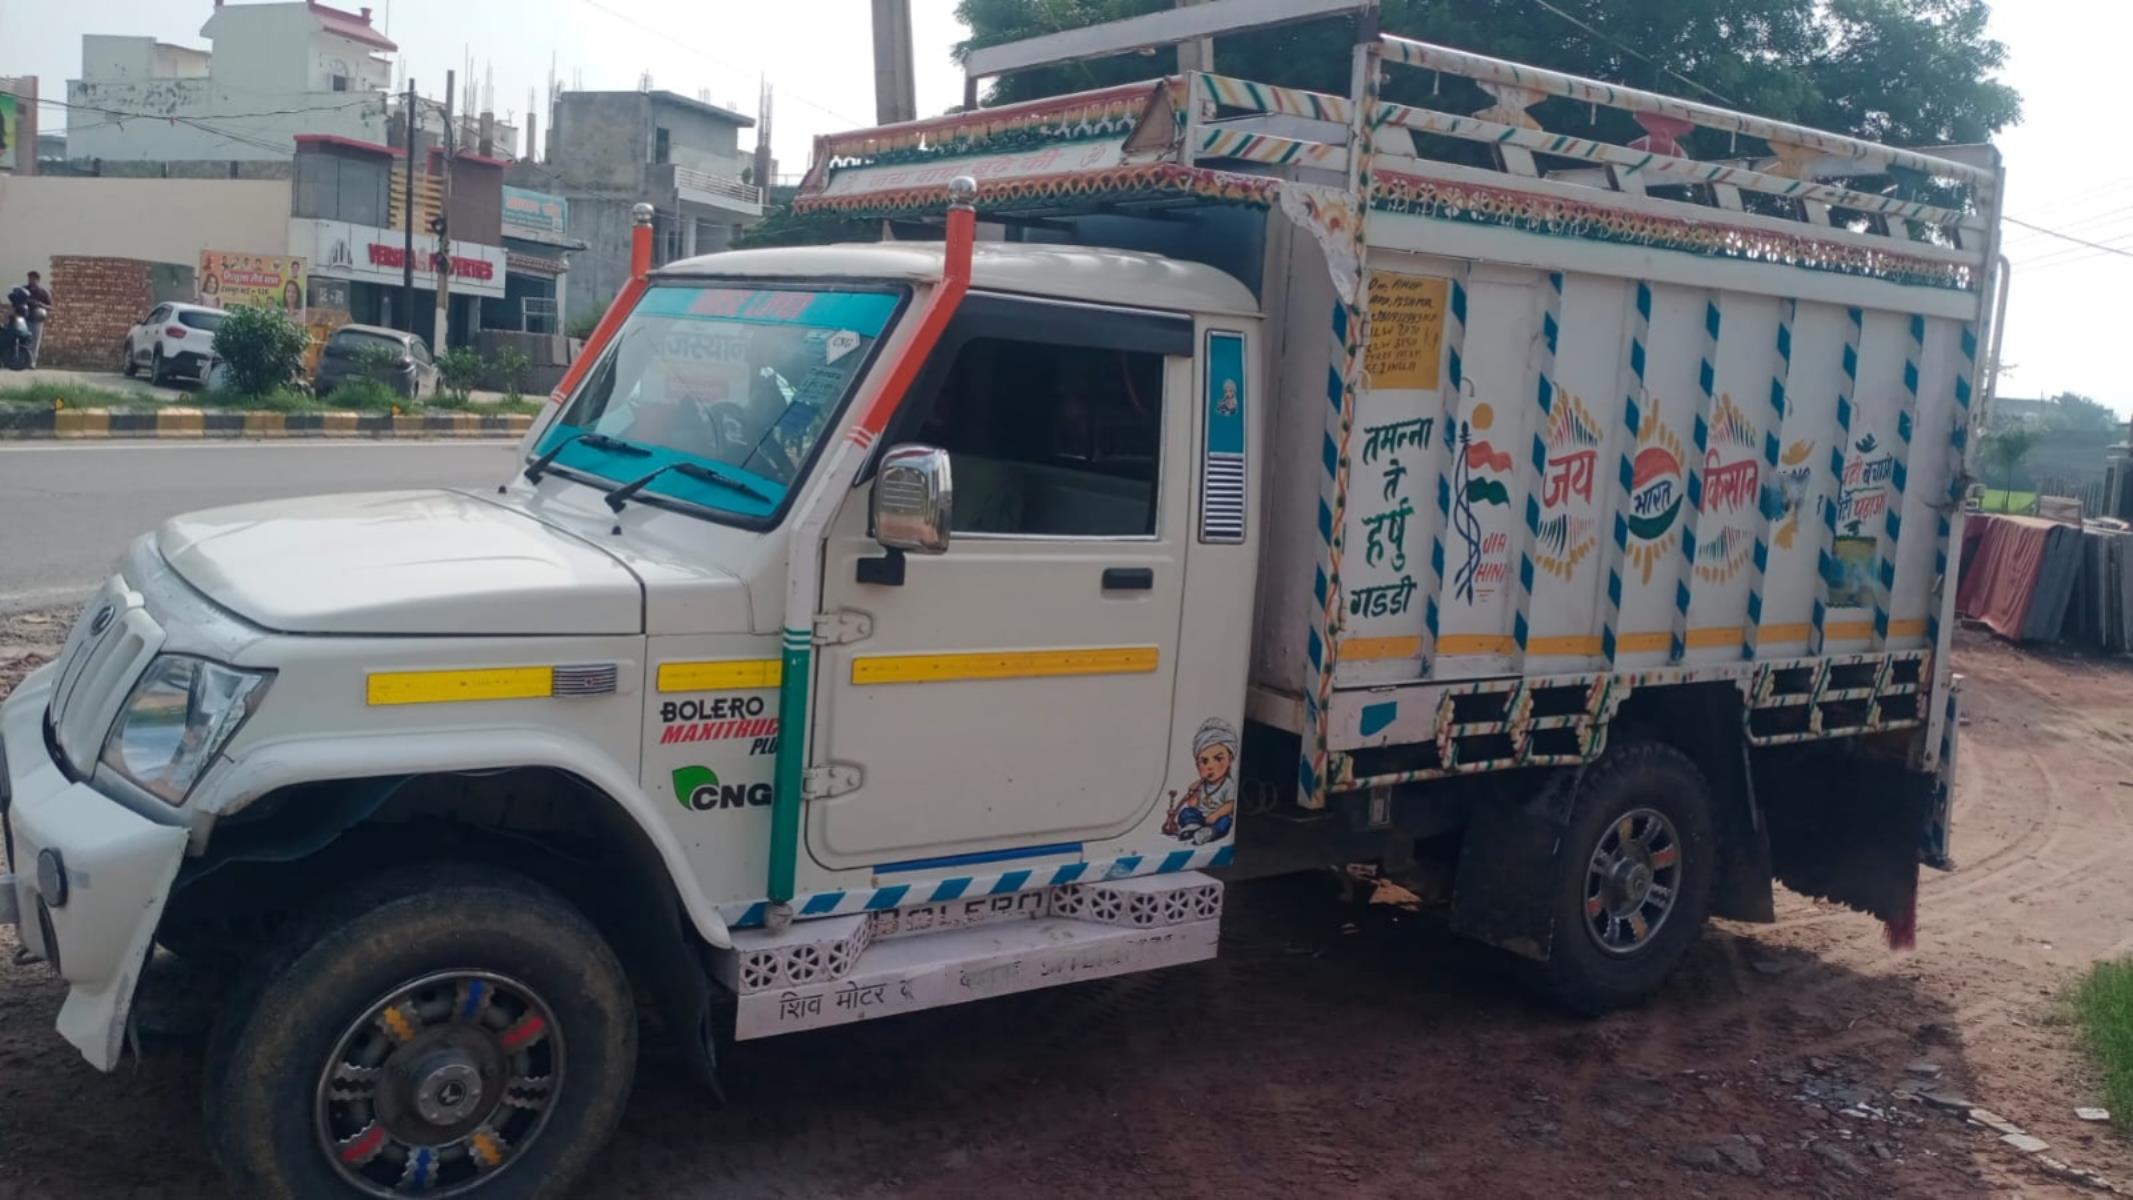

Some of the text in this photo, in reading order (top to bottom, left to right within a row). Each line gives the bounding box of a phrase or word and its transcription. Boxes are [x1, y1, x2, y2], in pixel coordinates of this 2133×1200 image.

[1362, 417, 1434, 466] तमन्ना
[1383, 458, 1407, 501] ते
[1542, 447, 1760, 516] जय भारत किसान
[660, 696, 765, 723] BOLERO
[660, 718, 779, 744] MAXITRUC
[750, 737, 778, 756] PLU
[691, 782, 773, 811] CNG
[779, 991, 823, 1021] शिव
[835, 981, 887, 1010] मोटर
